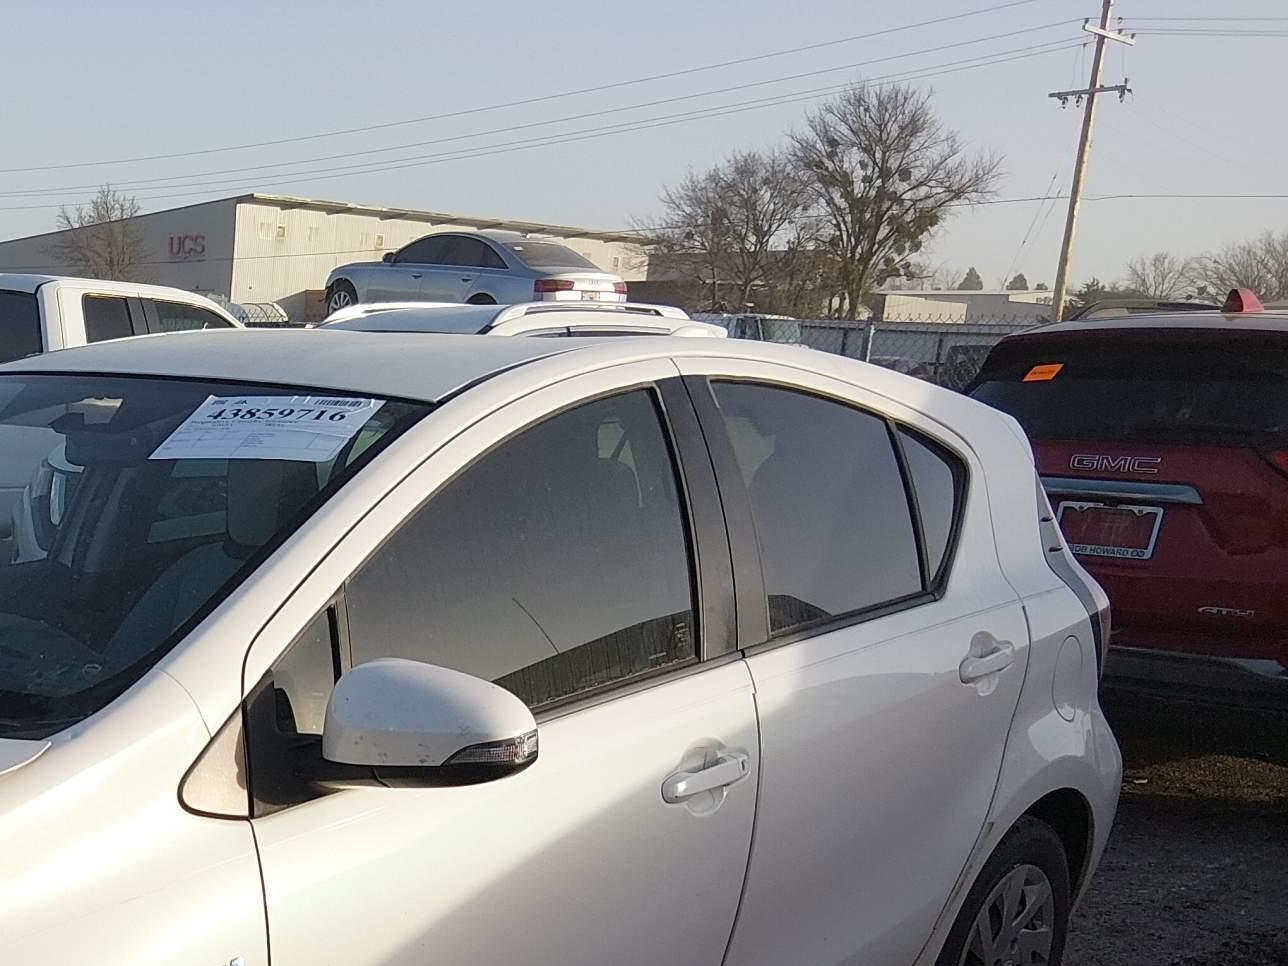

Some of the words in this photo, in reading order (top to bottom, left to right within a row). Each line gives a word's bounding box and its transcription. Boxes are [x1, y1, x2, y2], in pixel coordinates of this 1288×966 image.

[169, 234, 206, 256] UCS
[206, 407, 347, 422] 43859716
[1070, 454, 1162, 473] GMC
[1089, 546, 1129, 556] HOWARD
